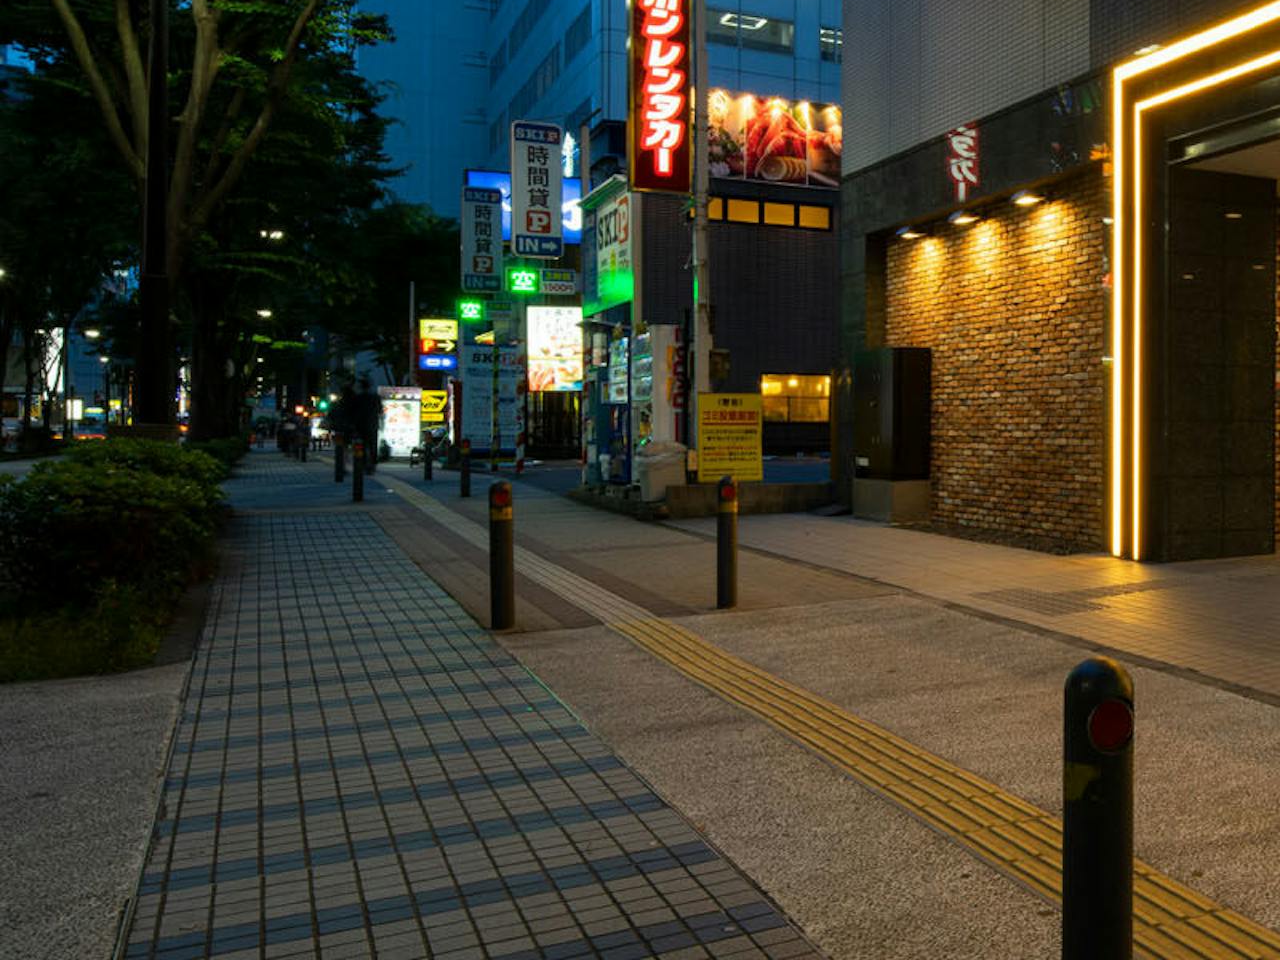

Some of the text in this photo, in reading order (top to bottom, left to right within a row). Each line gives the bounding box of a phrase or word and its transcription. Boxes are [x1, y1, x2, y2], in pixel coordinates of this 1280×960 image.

[527, 145, 550, 208] 時間貸
[518, 237, 540, 253] IN
[466, 276, 484, 288] IN
[511, 271, 536, 292] 空
